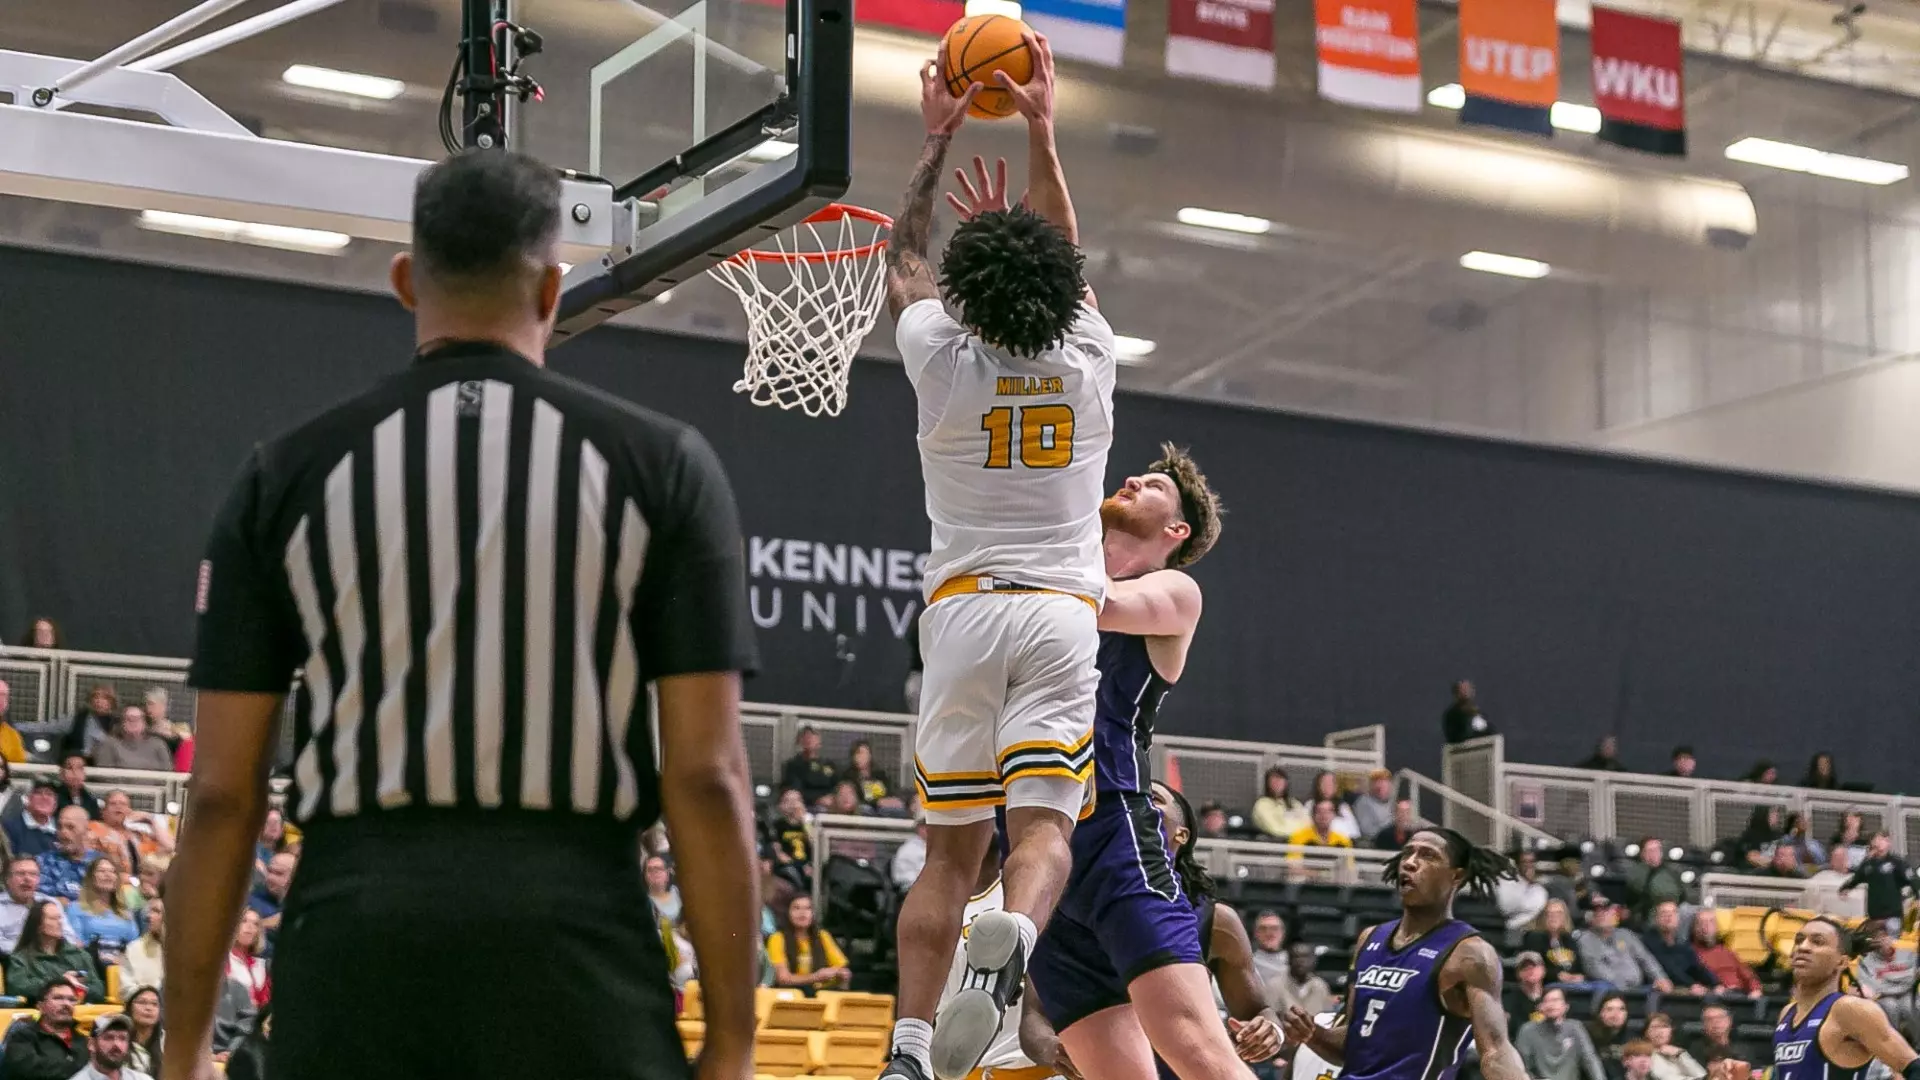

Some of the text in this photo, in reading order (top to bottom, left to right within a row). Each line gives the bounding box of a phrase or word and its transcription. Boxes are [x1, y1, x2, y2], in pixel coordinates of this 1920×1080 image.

[1466, 35, 1556, 81] UTEP
[1593, 56, 1681, 108] WKU
[996, 376, 1064, 396] MILLER
[981, 404, 1075, 469] 10
[1358, 967, 1408, 989] ACU
[1360, 999, 1386, 1038] 5
